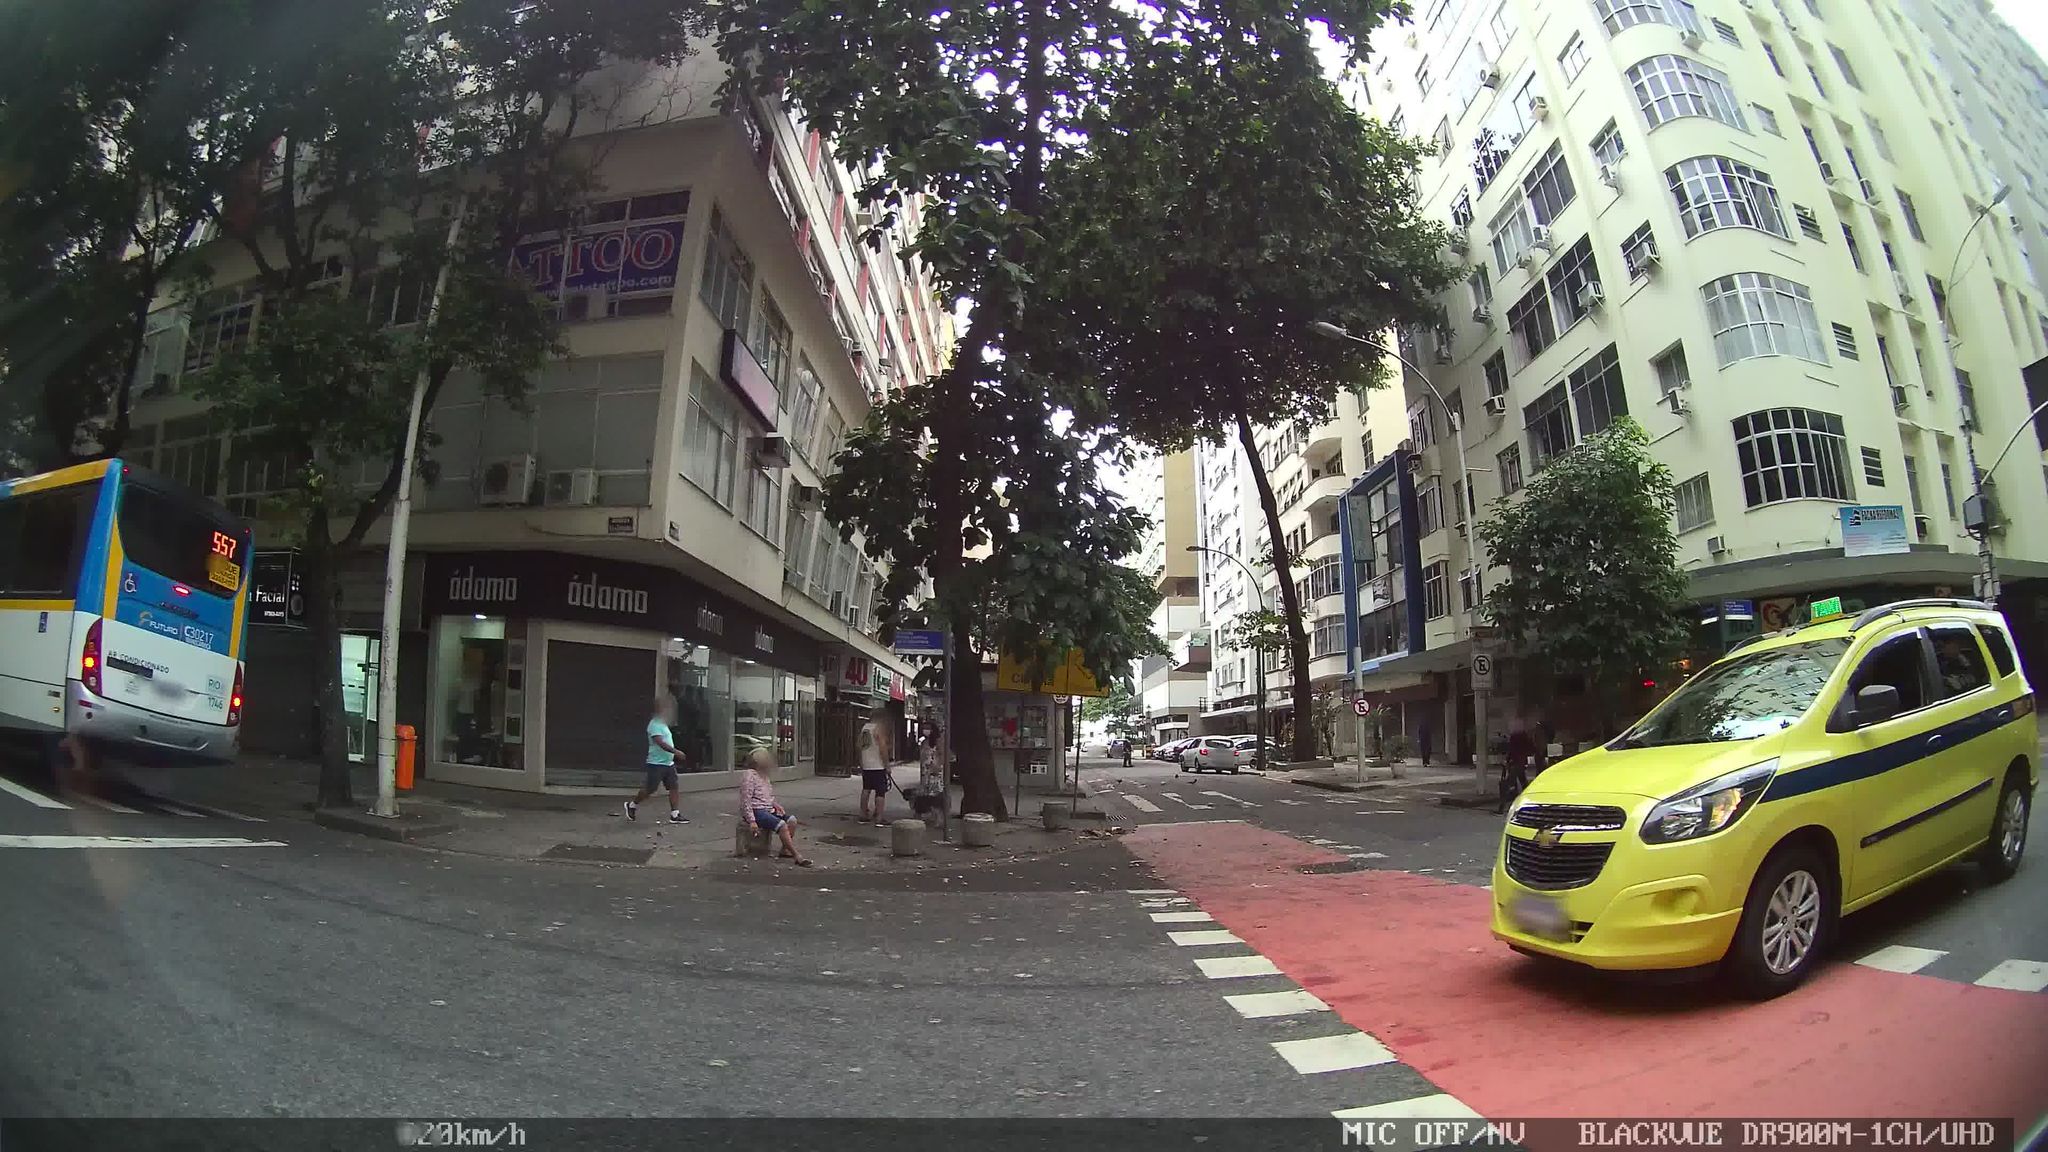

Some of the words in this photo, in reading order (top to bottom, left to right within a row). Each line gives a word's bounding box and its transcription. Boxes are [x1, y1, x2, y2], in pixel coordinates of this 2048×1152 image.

[505, 228, 675, 286] ATTOO
[212, 531, 237, 558] 557
[255, 584, 285, 602] Facial
[184, 625, 214, 644] C30217
[208, 679, 221, 690] RIO
[208, 697, 223, 710] 1746
